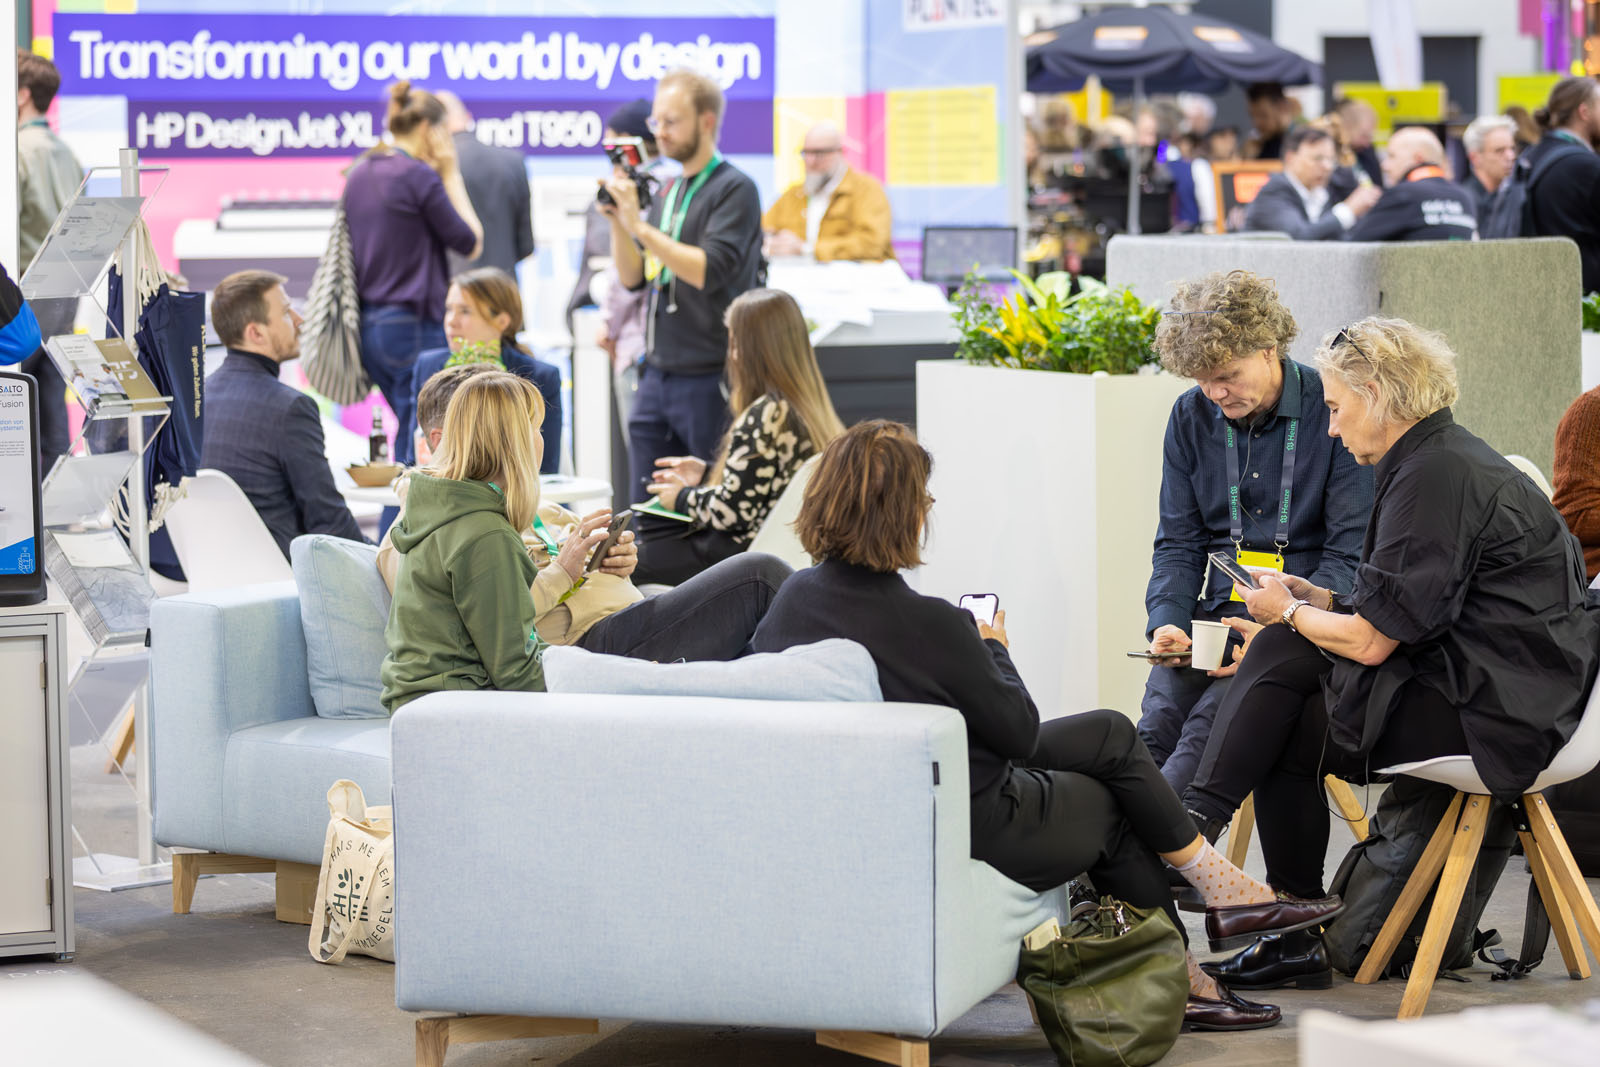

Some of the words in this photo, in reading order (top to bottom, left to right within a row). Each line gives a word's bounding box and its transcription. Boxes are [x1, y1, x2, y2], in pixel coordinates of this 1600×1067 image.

[69, 30, 359, 90] Transforming
[363, 41, 440, 80] our
[442, 31, 562, 80] world
[565, 32, 620, 89] by
[620, 32, 761, 90] design
[136, 111, 185, 149] HP
[186, 111, 340, 155] DesignJet
[340, 111, 376, 148] XL
[523, 111, 602, 147] T950
[1281, 489, 1290, 514] Heinze
